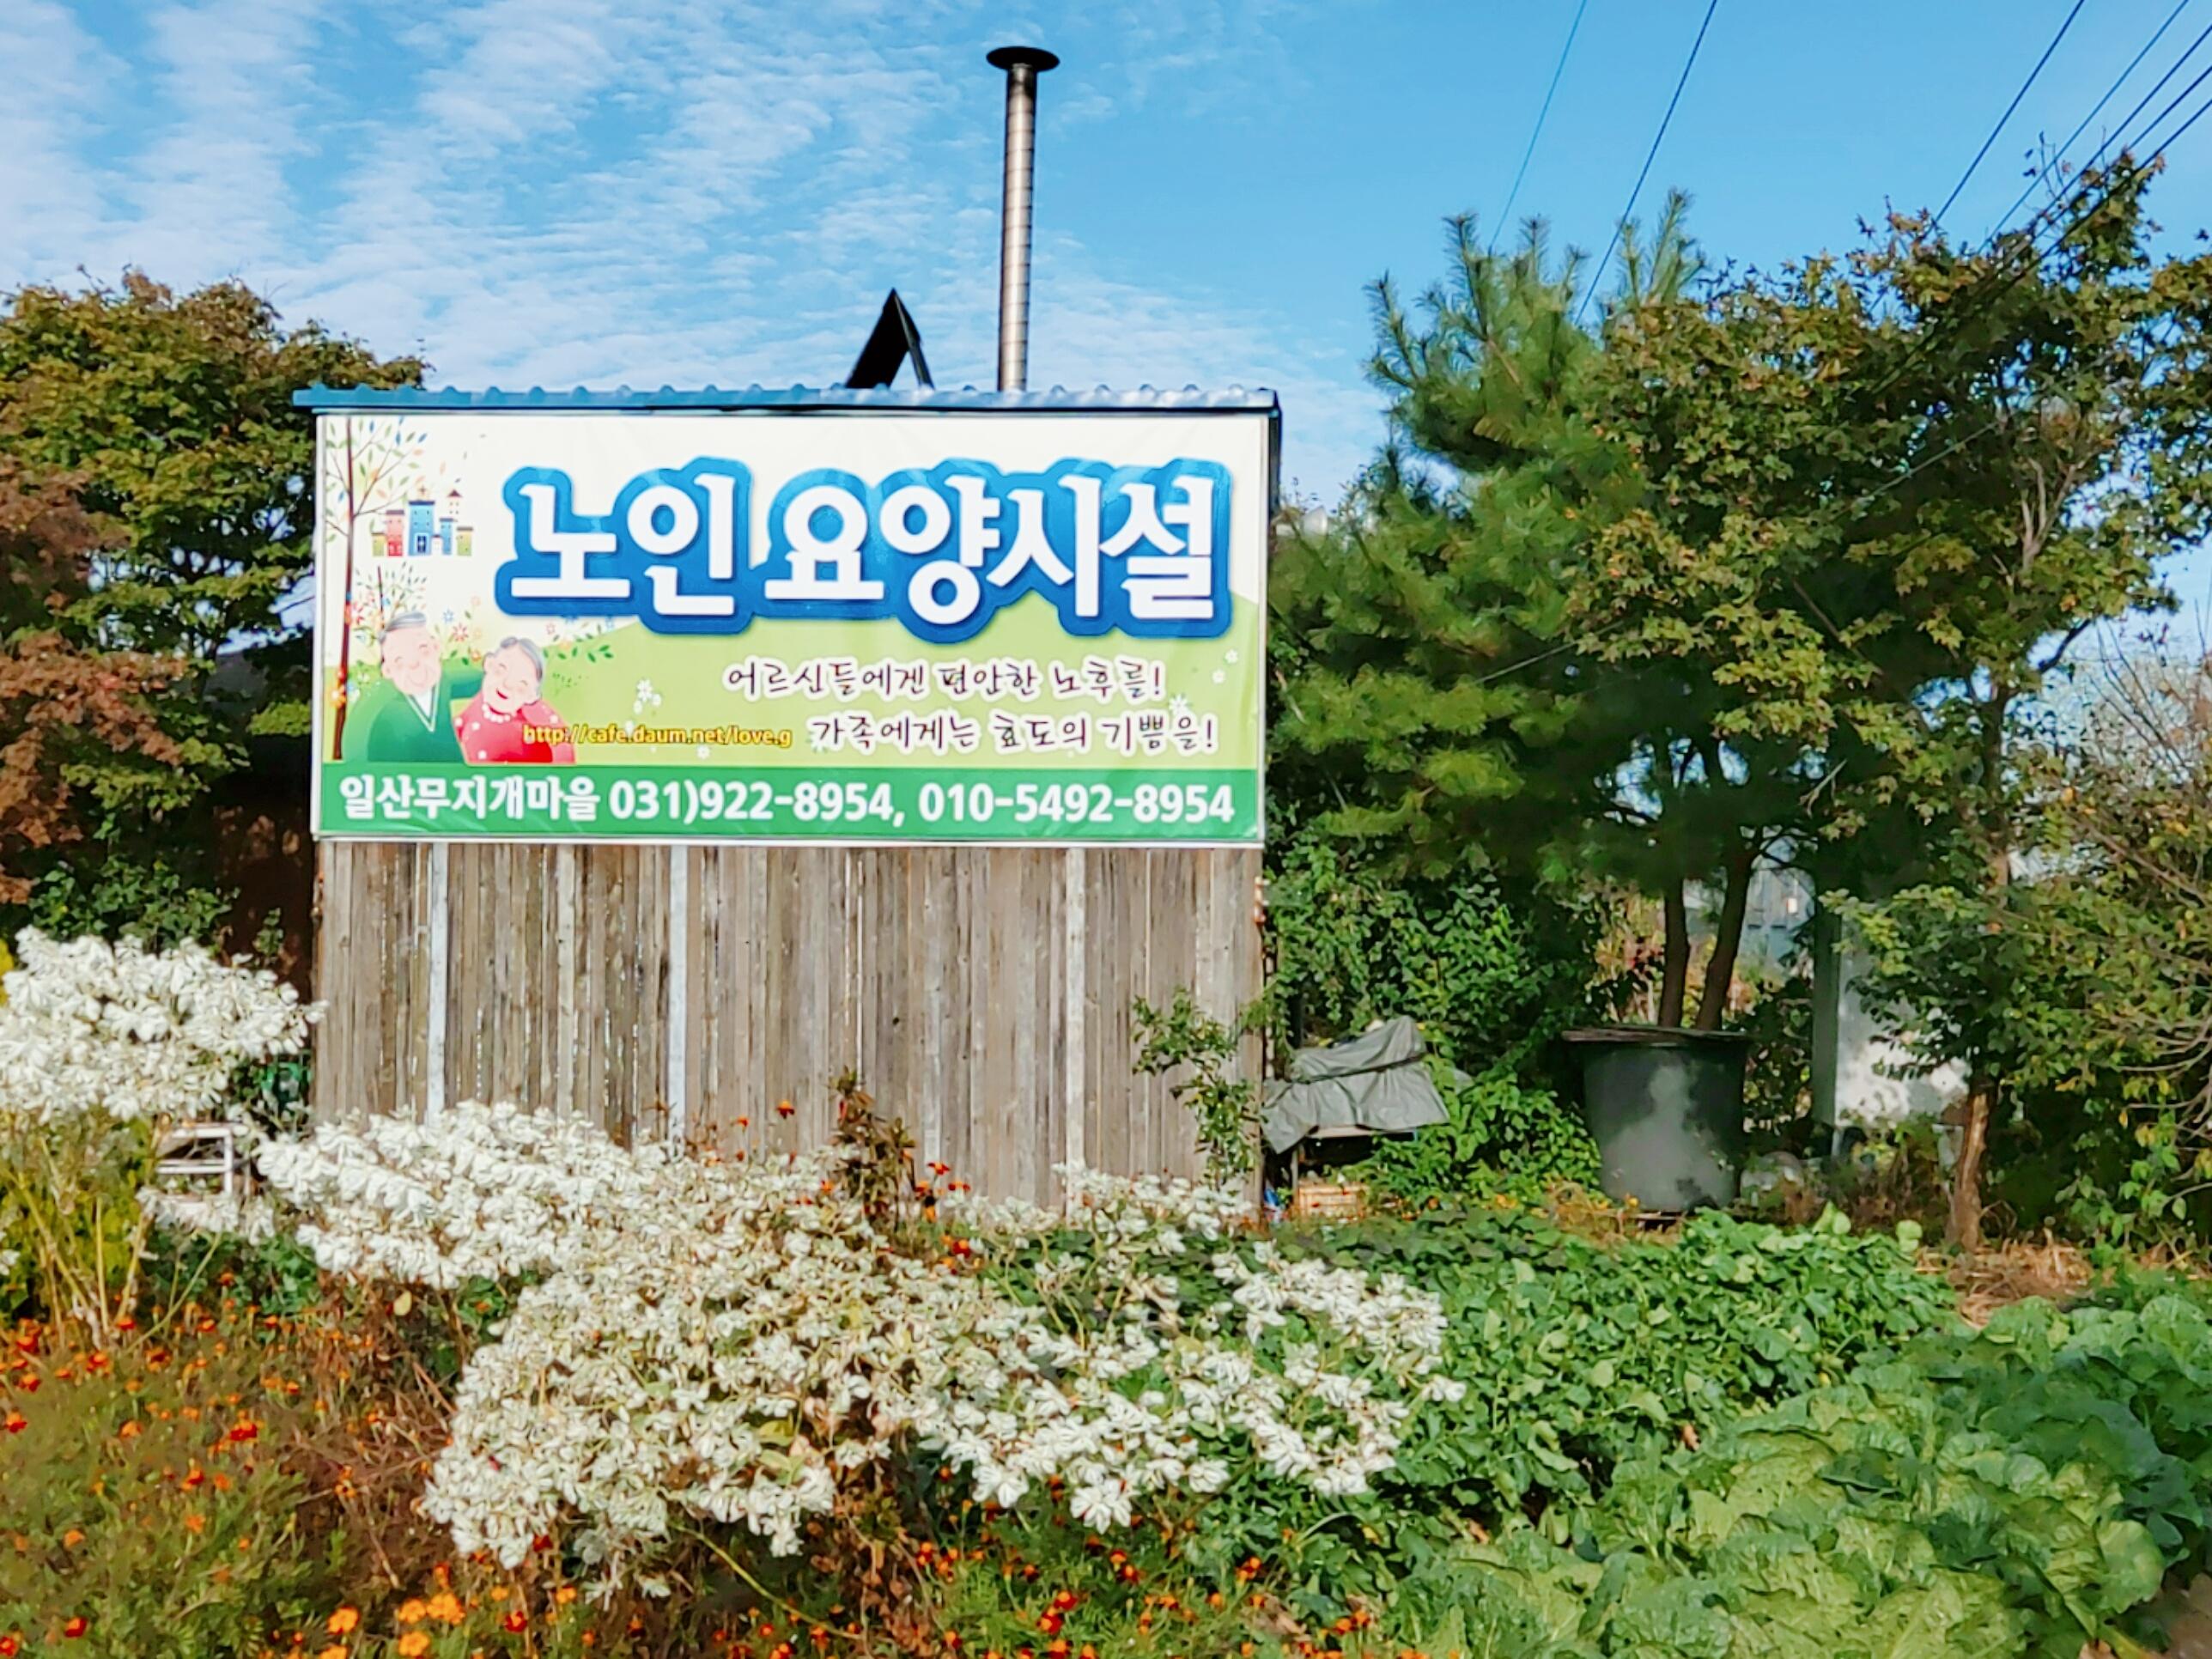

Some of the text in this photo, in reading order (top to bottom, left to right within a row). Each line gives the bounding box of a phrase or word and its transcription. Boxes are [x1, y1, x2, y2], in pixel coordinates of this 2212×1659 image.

[510, 472, 1214, 625] 노인 요양시설
[729, 660, 1161, 698] 어르신들에겐 편안한 노후를!
[522, 724, 793, 749] http://cafe.daum.net/love.g
[812, 714, 1213, 751] 가족에게는 효도의 기쁨을!
[339, 774, 1236, 827] 일산무지개마을 031)922-8954, 010-5492-8954
